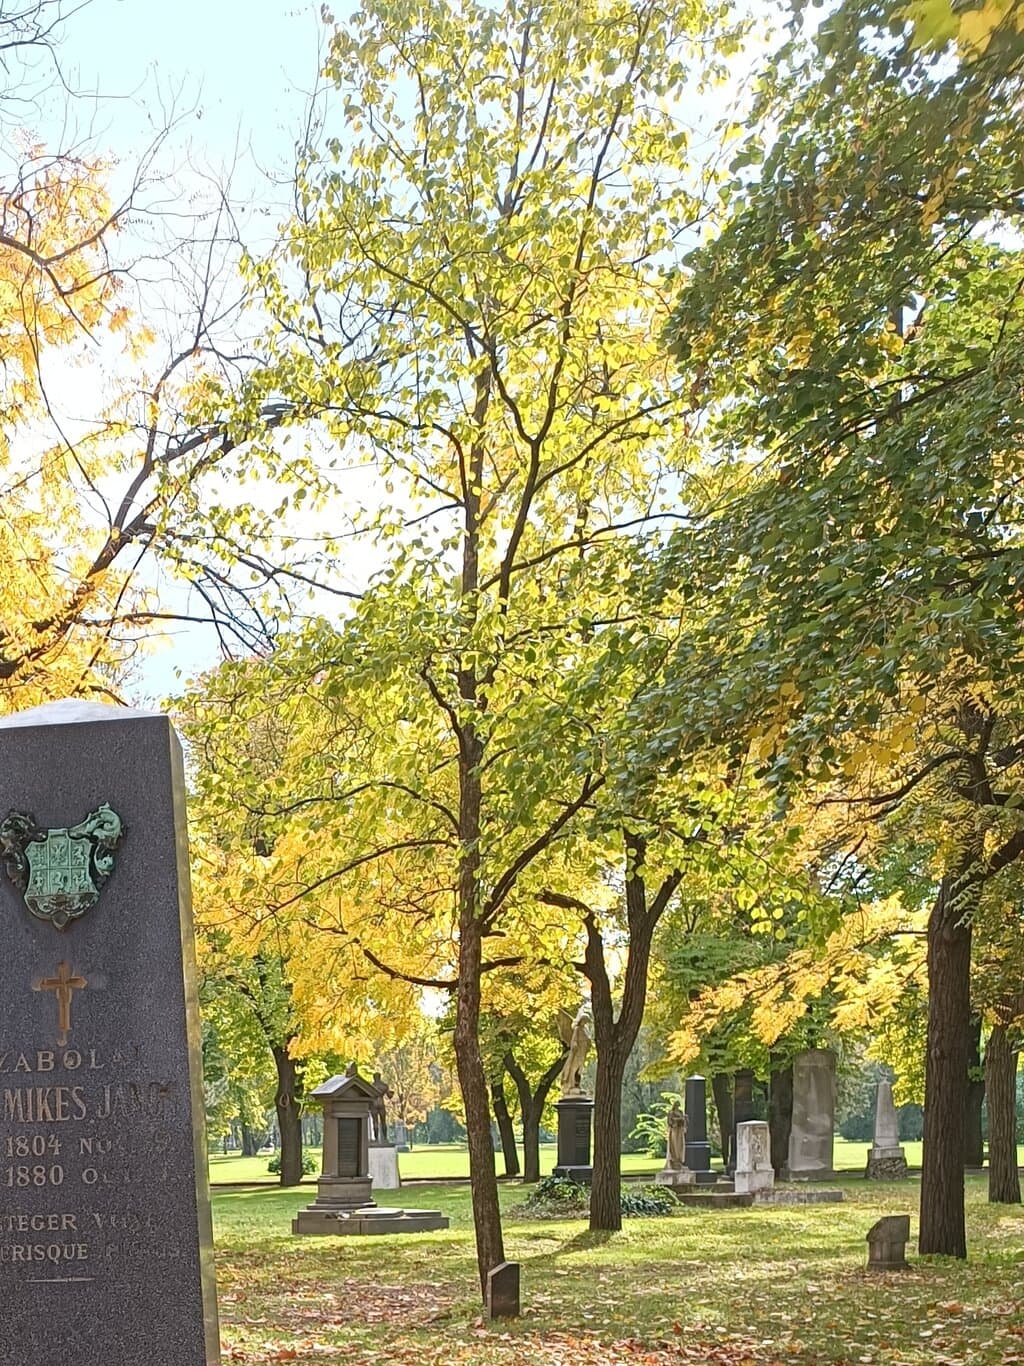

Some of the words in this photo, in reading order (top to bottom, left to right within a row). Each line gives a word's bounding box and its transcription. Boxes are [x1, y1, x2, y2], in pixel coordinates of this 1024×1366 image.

[3, 1086, 87, 1123] MIKES
[5, 1134, 61, 1157] 1804
[5, 1164, 64, 1188] 1880
